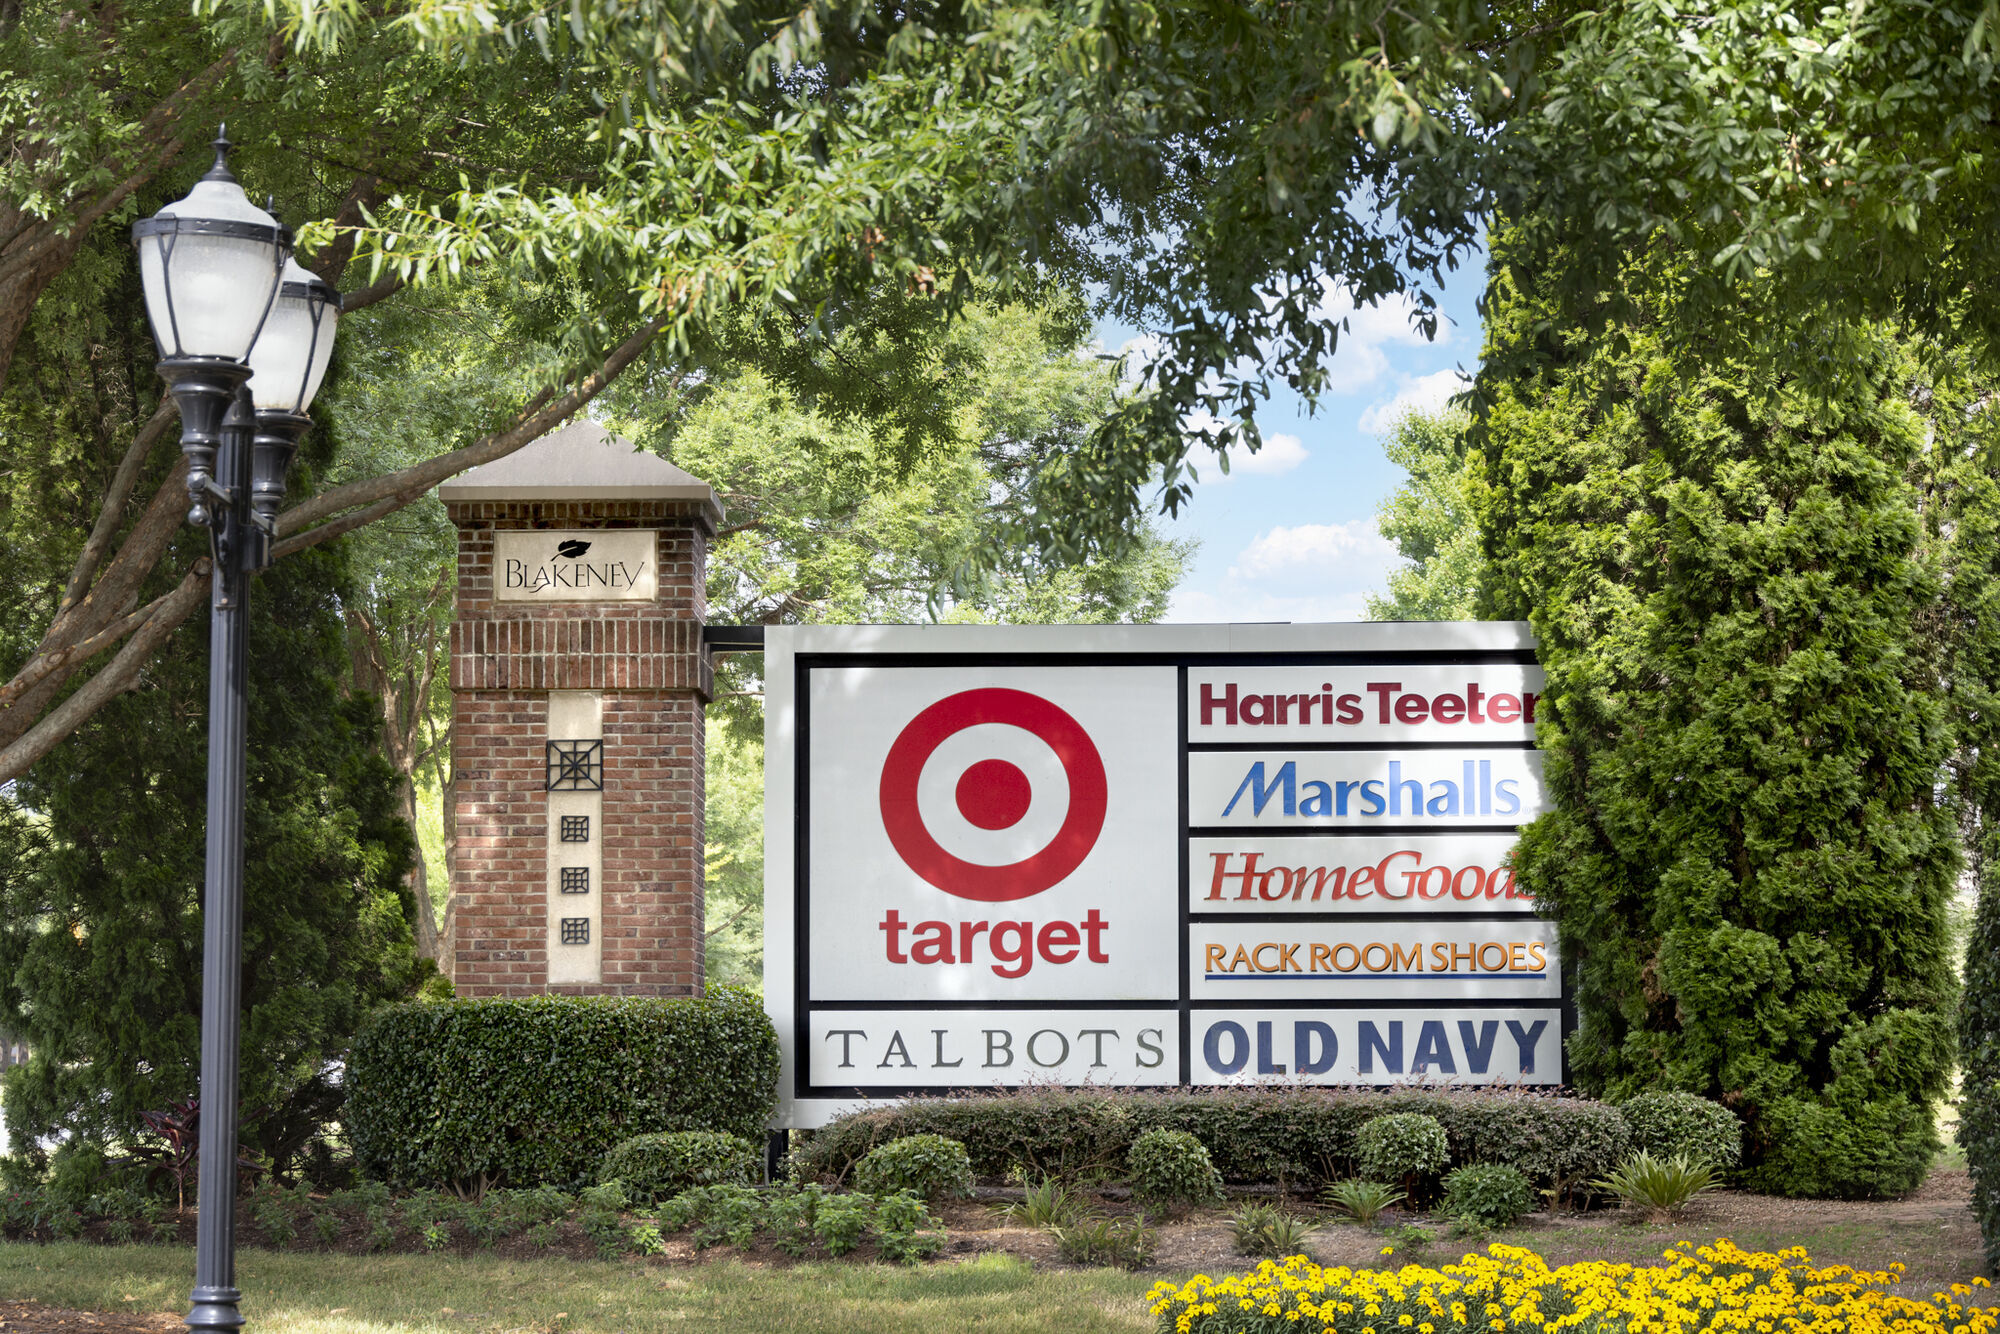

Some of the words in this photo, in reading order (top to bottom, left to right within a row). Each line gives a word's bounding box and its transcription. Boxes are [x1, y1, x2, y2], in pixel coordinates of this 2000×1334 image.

[506, 558, 645, 594] BLAKENEY
[1200, 682, 1364, 725] Harris
[1221, 759, 1521, 817] Marshalls
[1203, 850, 1537, 901] HomeGood
[879, 909, 1109, 979] target
[1205, 942, 1302, 972] RACK
[1310, 942, 1423, 972] ROOM
[1431, 941, 1547, 972] SHOES
[825, 1028, 1164, 1069] TALBOTS
[1203, 1020, 1338, 1075] OLD
[1358, 1020, 1549, 1075] NAVY
